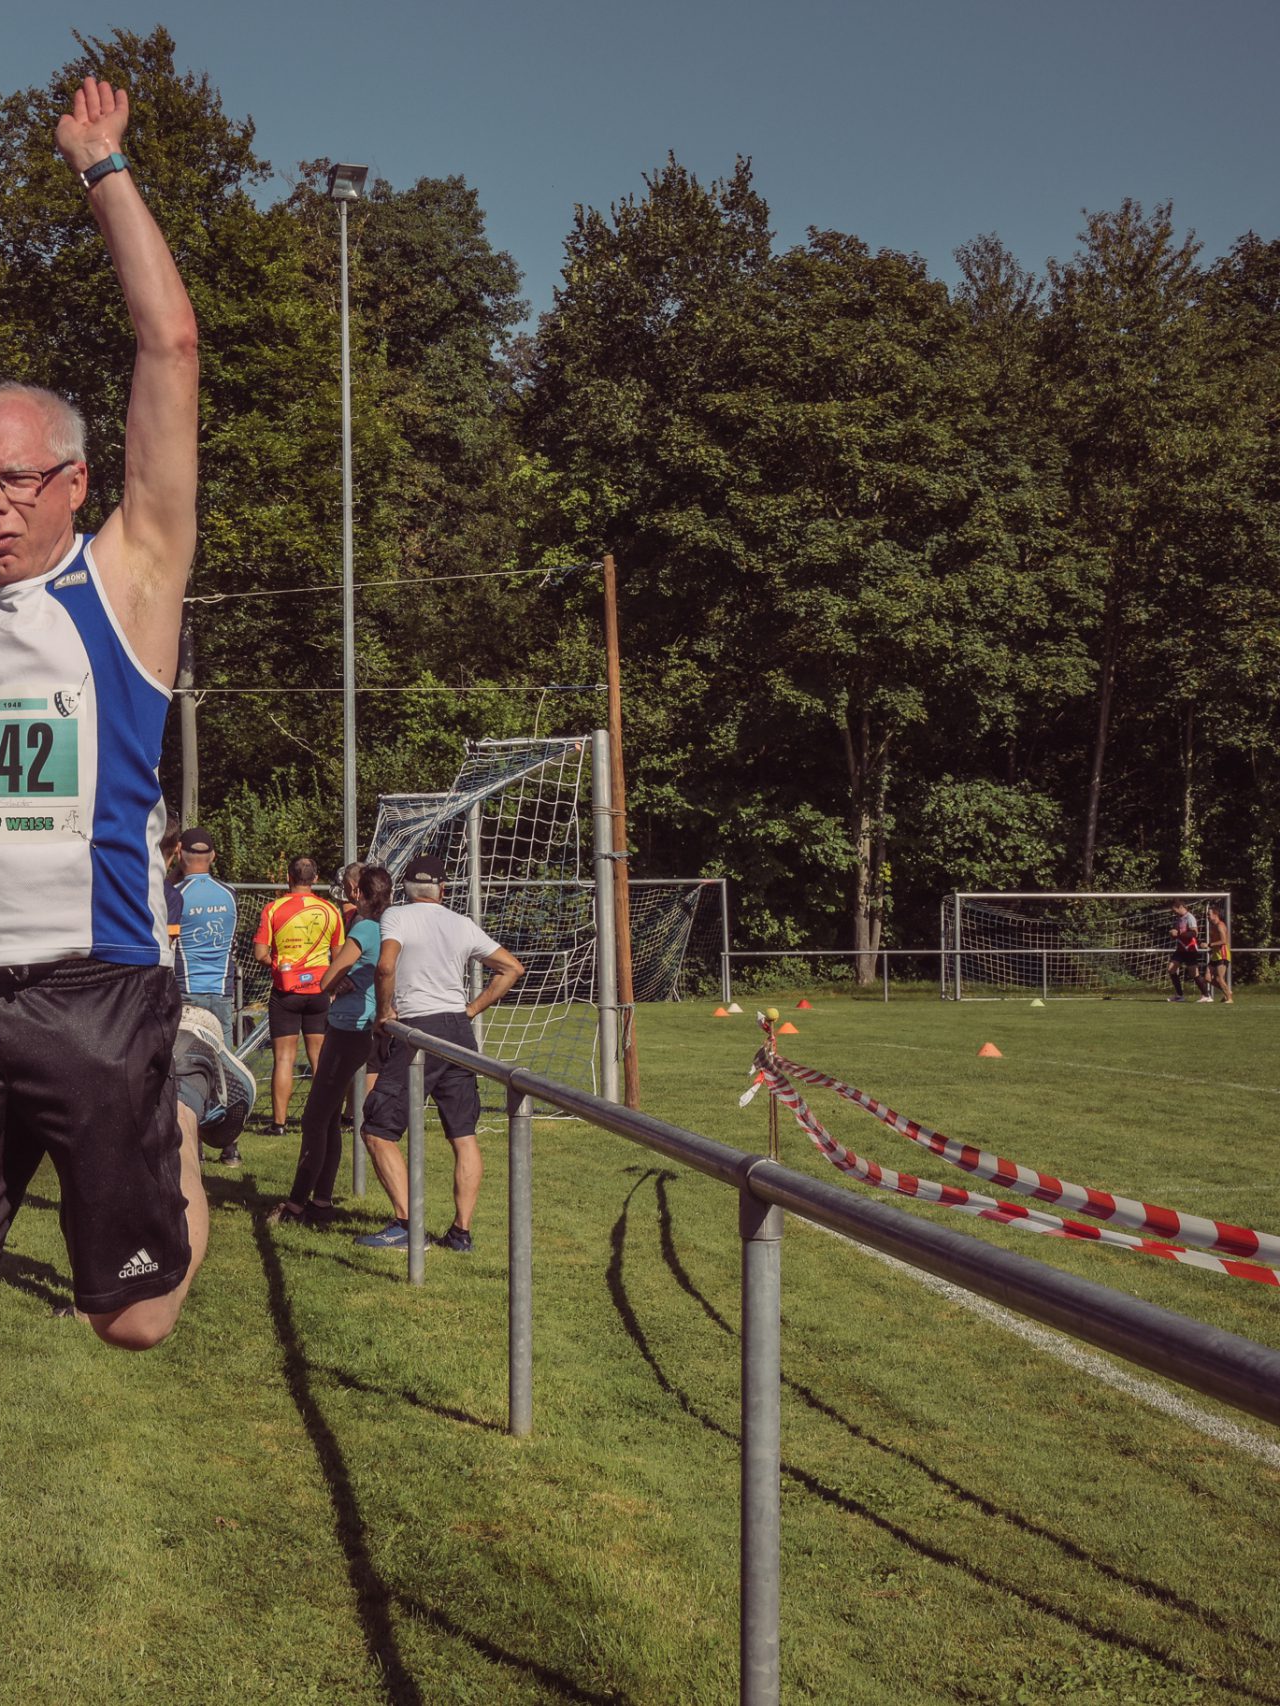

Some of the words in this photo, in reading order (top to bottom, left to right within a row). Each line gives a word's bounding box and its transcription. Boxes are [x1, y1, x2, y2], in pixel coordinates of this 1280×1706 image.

[5, 816, 54, 831] WEISE
[189, 906, 203, 916] SV
[207, 905, 227, 914] ULM
[118, 1262, 159, 1279] adidas
